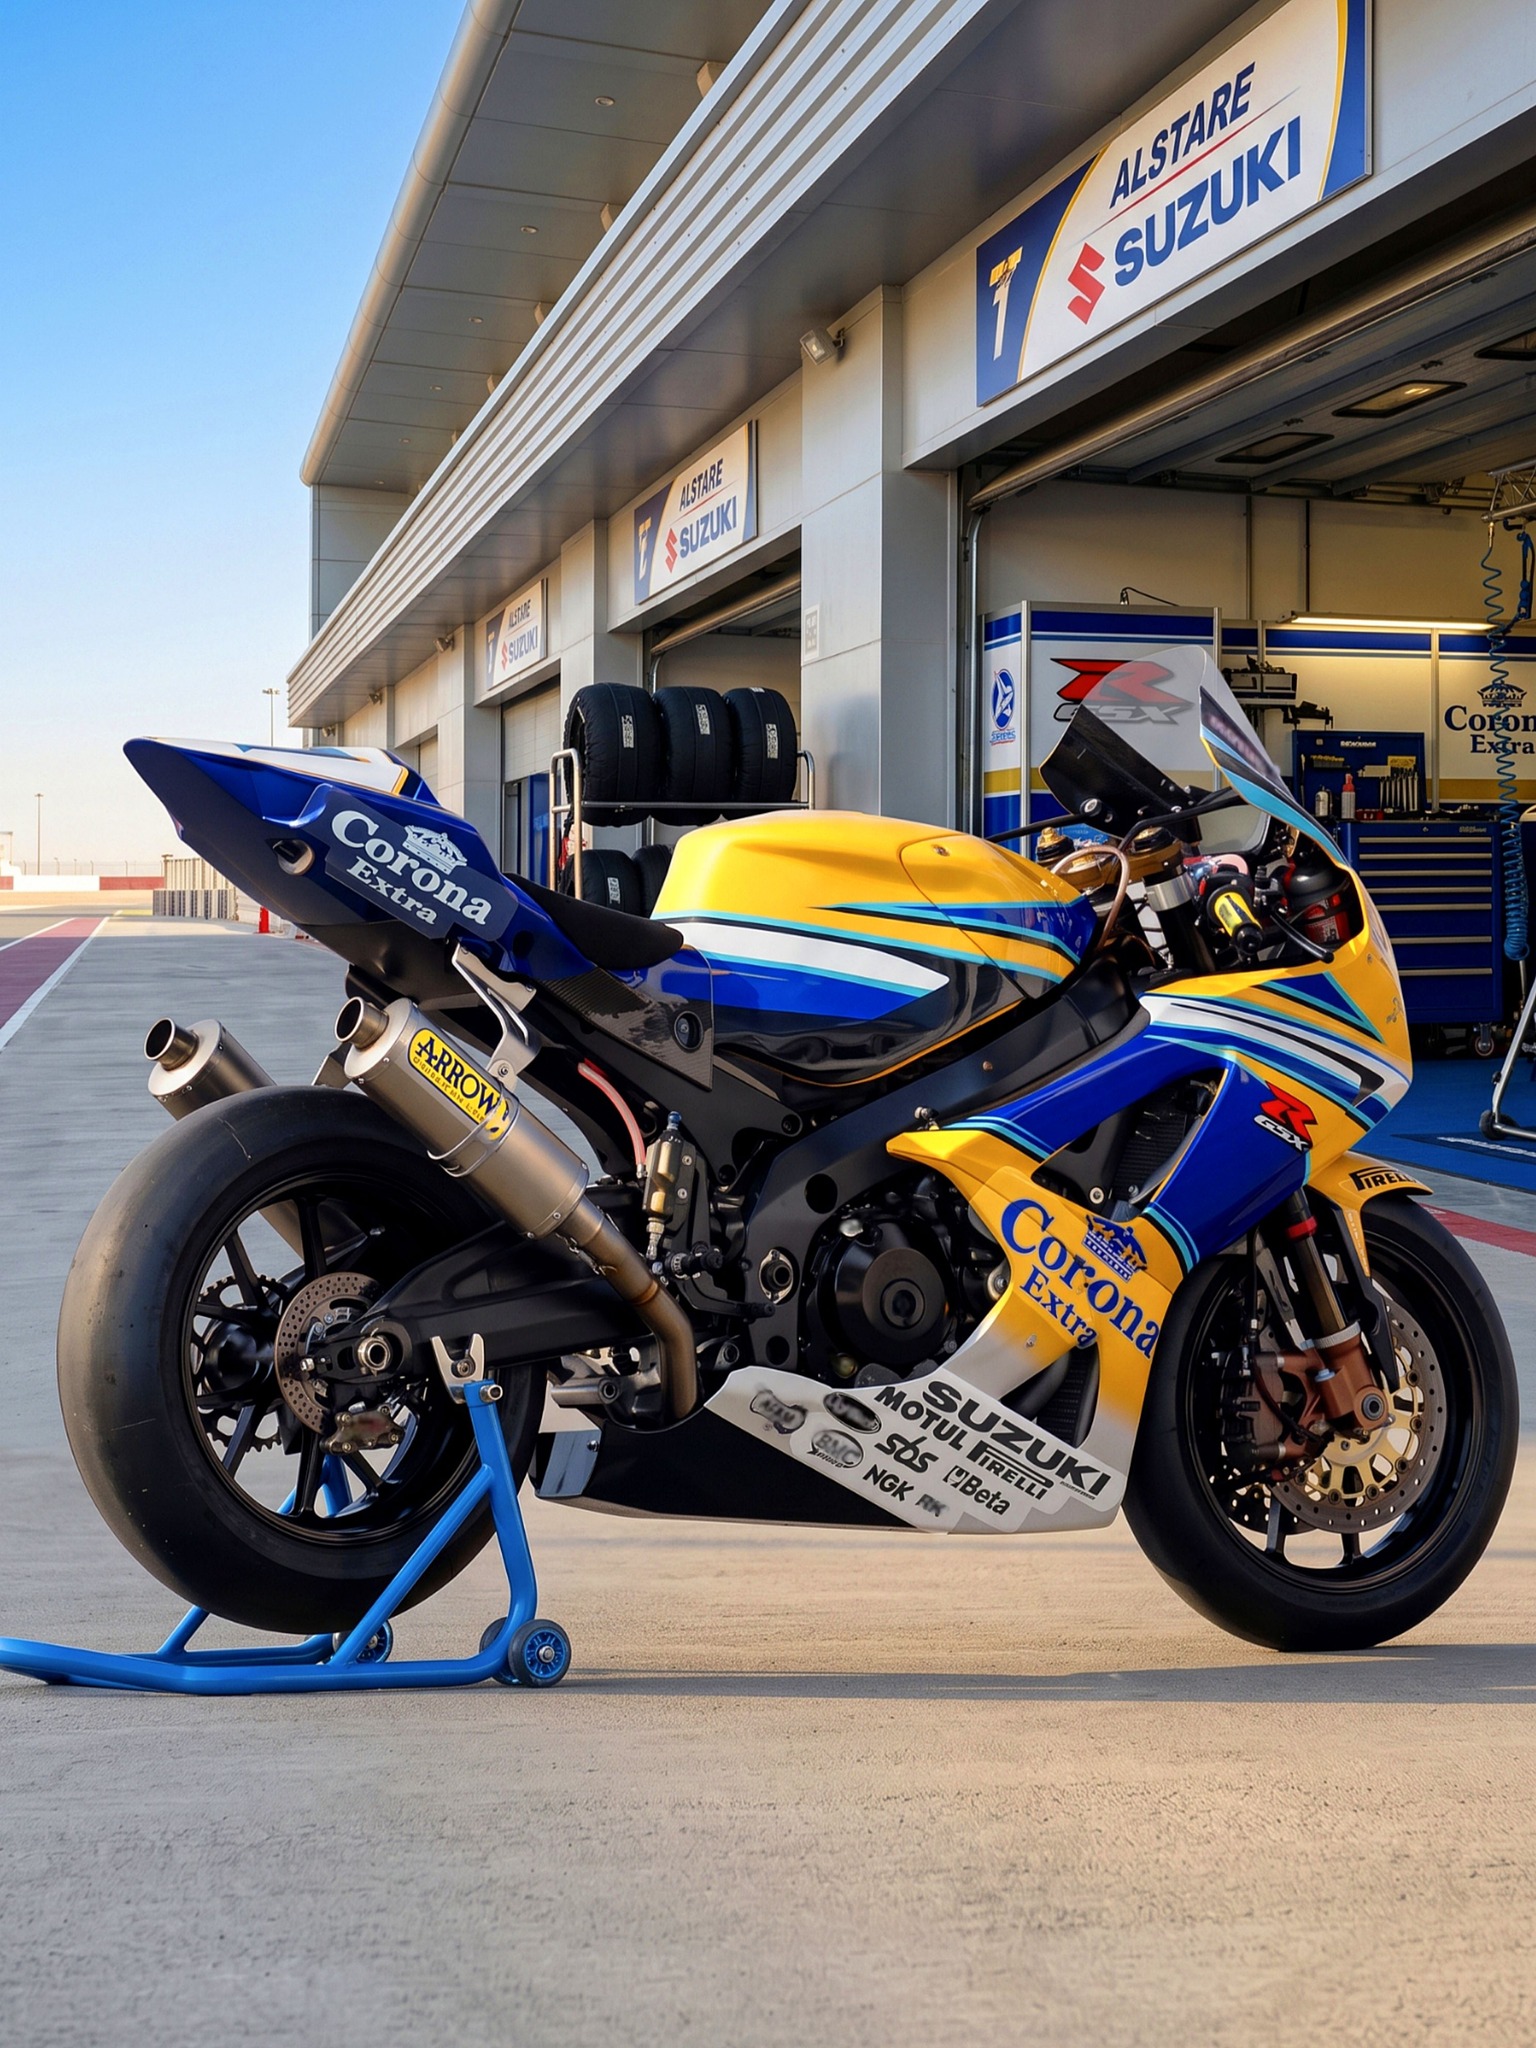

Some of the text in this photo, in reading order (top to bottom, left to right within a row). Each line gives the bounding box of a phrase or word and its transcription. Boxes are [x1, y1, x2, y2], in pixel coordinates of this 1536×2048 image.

[1109, 60, 1256, 209] ALSTARE
[1114, 115, 1301, 287] SUZUKI
[679, 458, 723, 512] ALSTARE
[680, 495, 737, 558] SUZUKI
[509, 625, 538, 663] SUZUKI
[331, 810, 493, 925] Corona
[346, 857, 438, 925] Extra
[1254, 1114, 1308, 1151] GSX
[1348, 1166, 1417, 1191] PIRELL
[1000, 1198, 1160, 1359] Corona
[1019, 1264, 1099, 1347] Extra
[874, 1386, 967, 1451] MOTUL
[922, 1381, 1111, 1496] SUZUKI
[863, 1464, 914, 1502] NGK
[959, 1474, 1010, 1515] Beta
[966, 1440, 1055, 1500] PIRELLI
